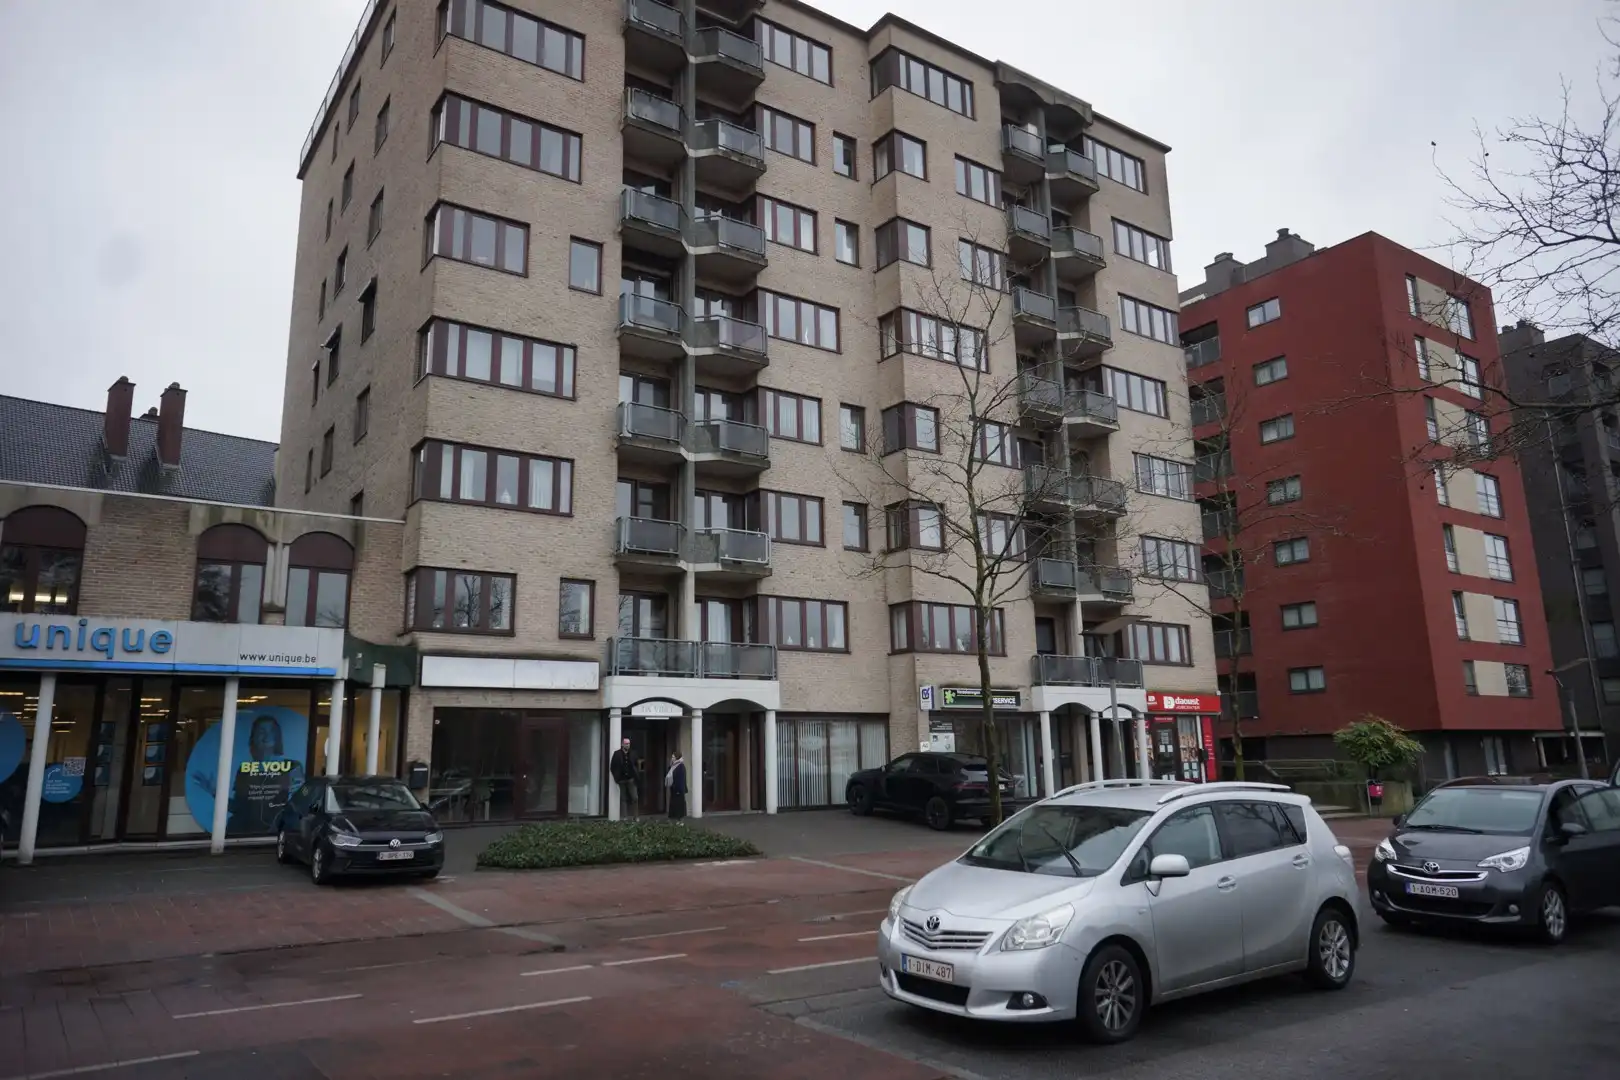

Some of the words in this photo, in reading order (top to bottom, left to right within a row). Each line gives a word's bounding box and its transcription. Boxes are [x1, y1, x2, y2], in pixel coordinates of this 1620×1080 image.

[14, 618, 173, 660] unique
[239, 652, 317, 665] www.unique.be
[1175, 696, 1200, 705] daoust
[240, 761, 260, 773] BE
[262, 761, 292, 772] YOU
[908, 958, 951, 979] 1-DIM-487
